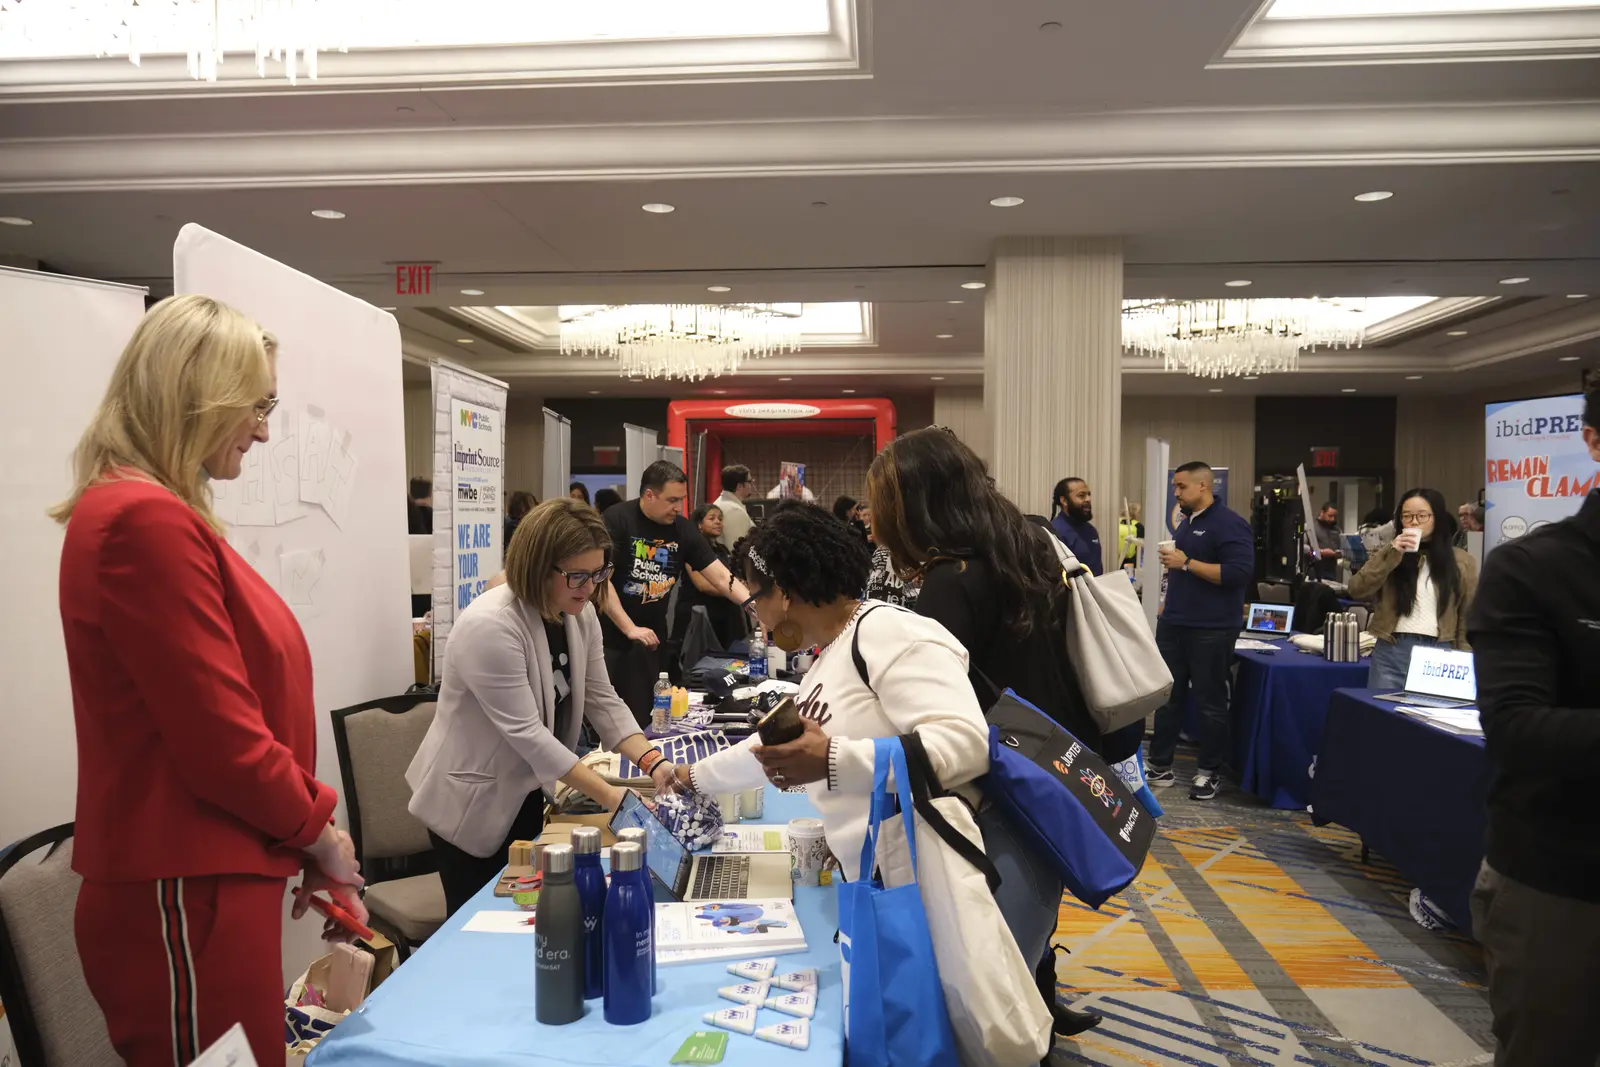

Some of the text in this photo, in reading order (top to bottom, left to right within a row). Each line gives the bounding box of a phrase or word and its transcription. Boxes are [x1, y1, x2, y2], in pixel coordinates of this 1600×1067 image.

[396, 265, 433, 295] EXIT
[461, 408, 478, 429] NYC
[1495, 414, 1584, 438] ibidPRE
[1487, 455, 1549, 483] REMAIN
[458, 523, 491, 549] WE ARE
[458, 552, 479, 580] YOUR
[630, 569, 668, 583] Schools
[633, 558, 661, 573] Public
[723, 673, 737, 687] NY
[1422, 661, 1470, 680] ibidPREP
[1060, 741, 1083, 768] JUPITER
[1123, 806, 1140, 836] PRACTICE
